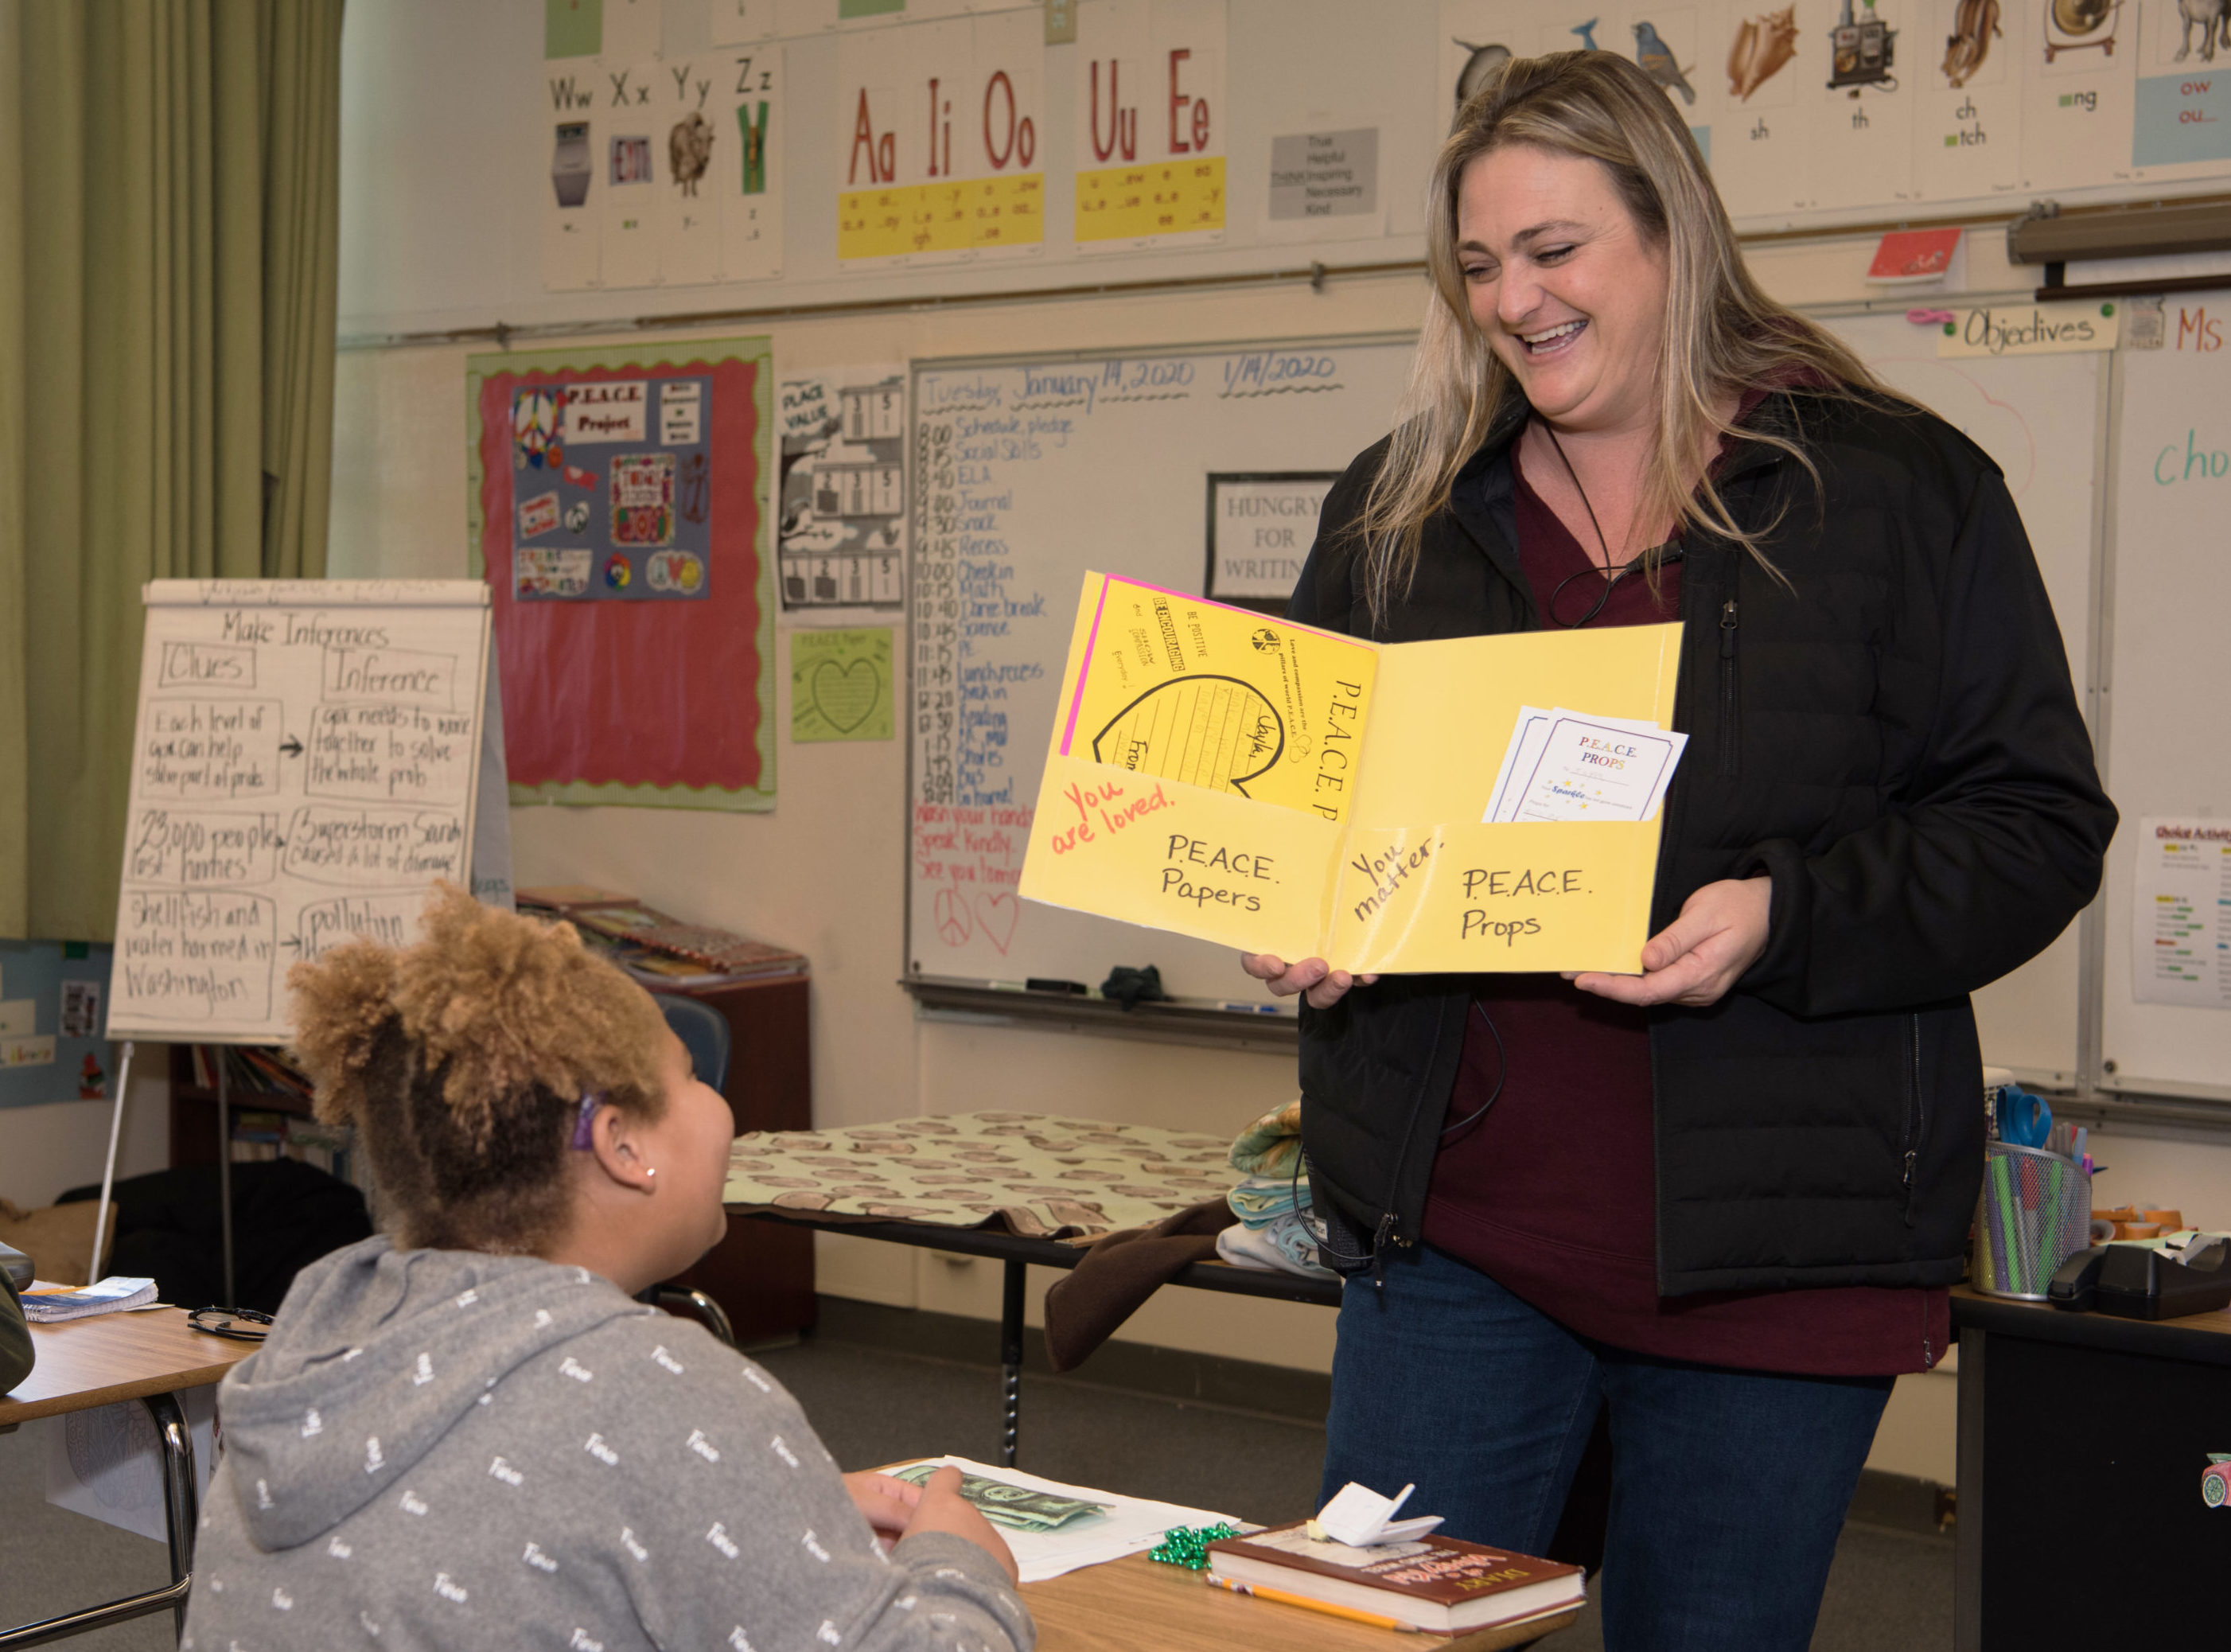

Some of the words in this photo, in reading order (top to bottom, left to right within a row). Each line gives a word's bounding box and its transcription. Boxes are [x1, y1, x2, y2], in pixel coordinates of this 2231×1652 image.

[609, 68, 649, 107] Xx
[671, 64, 711, 111] Yy
[735, 56, 773, 94] Zz
[2180, 80, 2212, 96] ow
[549, 76, 593, 111] Ww
[1089, 59, 1137, 163] Uu
[1168, 48, 1209, 154] Ee
[1956, 96, 1977, 121] ch
[2073, 88, 2097, 112] ng
[847, 86, 896, 185] Aa
[928, 77, 951, 177] Ii
[982, 69, 1035, 170] Oo
[1750, 117, 1770, 141] sh
[1851, 107, 1870, 130] th
[1960, 122, 1987, 147] tch
[1964, 308, 2096, 355] Objectives
[781, 384, 824, 411] PLACE
[1014, 368, 1100, 414] January
[1224, 354, 1337, 393] 1/14/2020
[785, 403, 828, 431] VALUE
[882, 395, 892, 411] 5
[576, 413, 631, 434] Project
[882, 472, 893, 489] 5
[1228, 495, 1322, 517] HUNGRY
[1254, 528, 1296, 549] FOR
[882, 559, 891, 575] 5
[1225, 558, 1306, 579] WRITIN
[1153, 597, 1168, 611] BE
[1186, 611, 1198, 620] BE
[222, 611, 275, 643] Make
[280, 613, 390, 647] Inferences
[1139, 627, 1156, 664] SHOW
[1156, 610, 1186, 672] ENCOURAGING
[1190, 623, 1209, 658] POSITIVE
[168, 644, 243, 680] Clues
[328, 648, 440, 695] Inference
[1283, 683, 1292, 703] world
[1294, 668, 1305, 706] compassion
[1314, 680, 1362, 793] P.E.A.C.E.
[1579, 736, 1637, 758] P.E.A.C.E.
[1581, 751, 1626, 770] PROPS
[1051, 821, 1096, 855] are
[1100, 782, 1177, 835] loved.
[1063, 781, 1124, 822] You
[1167, 834, 1281, 885] P.E.A.C.E.
[1351, 845, 1406, 886] You
[1162, 867, 1261, 912] Papers
[1353, 836, 1446, 922] matter.
[1462, 869, 1594, 900] P.E.A.C.E.
[1461, 909, 1543, 948] Props
[125, 962, 251, 1019] Washington
[1454, 1568, 1531, 1592] DIARY
